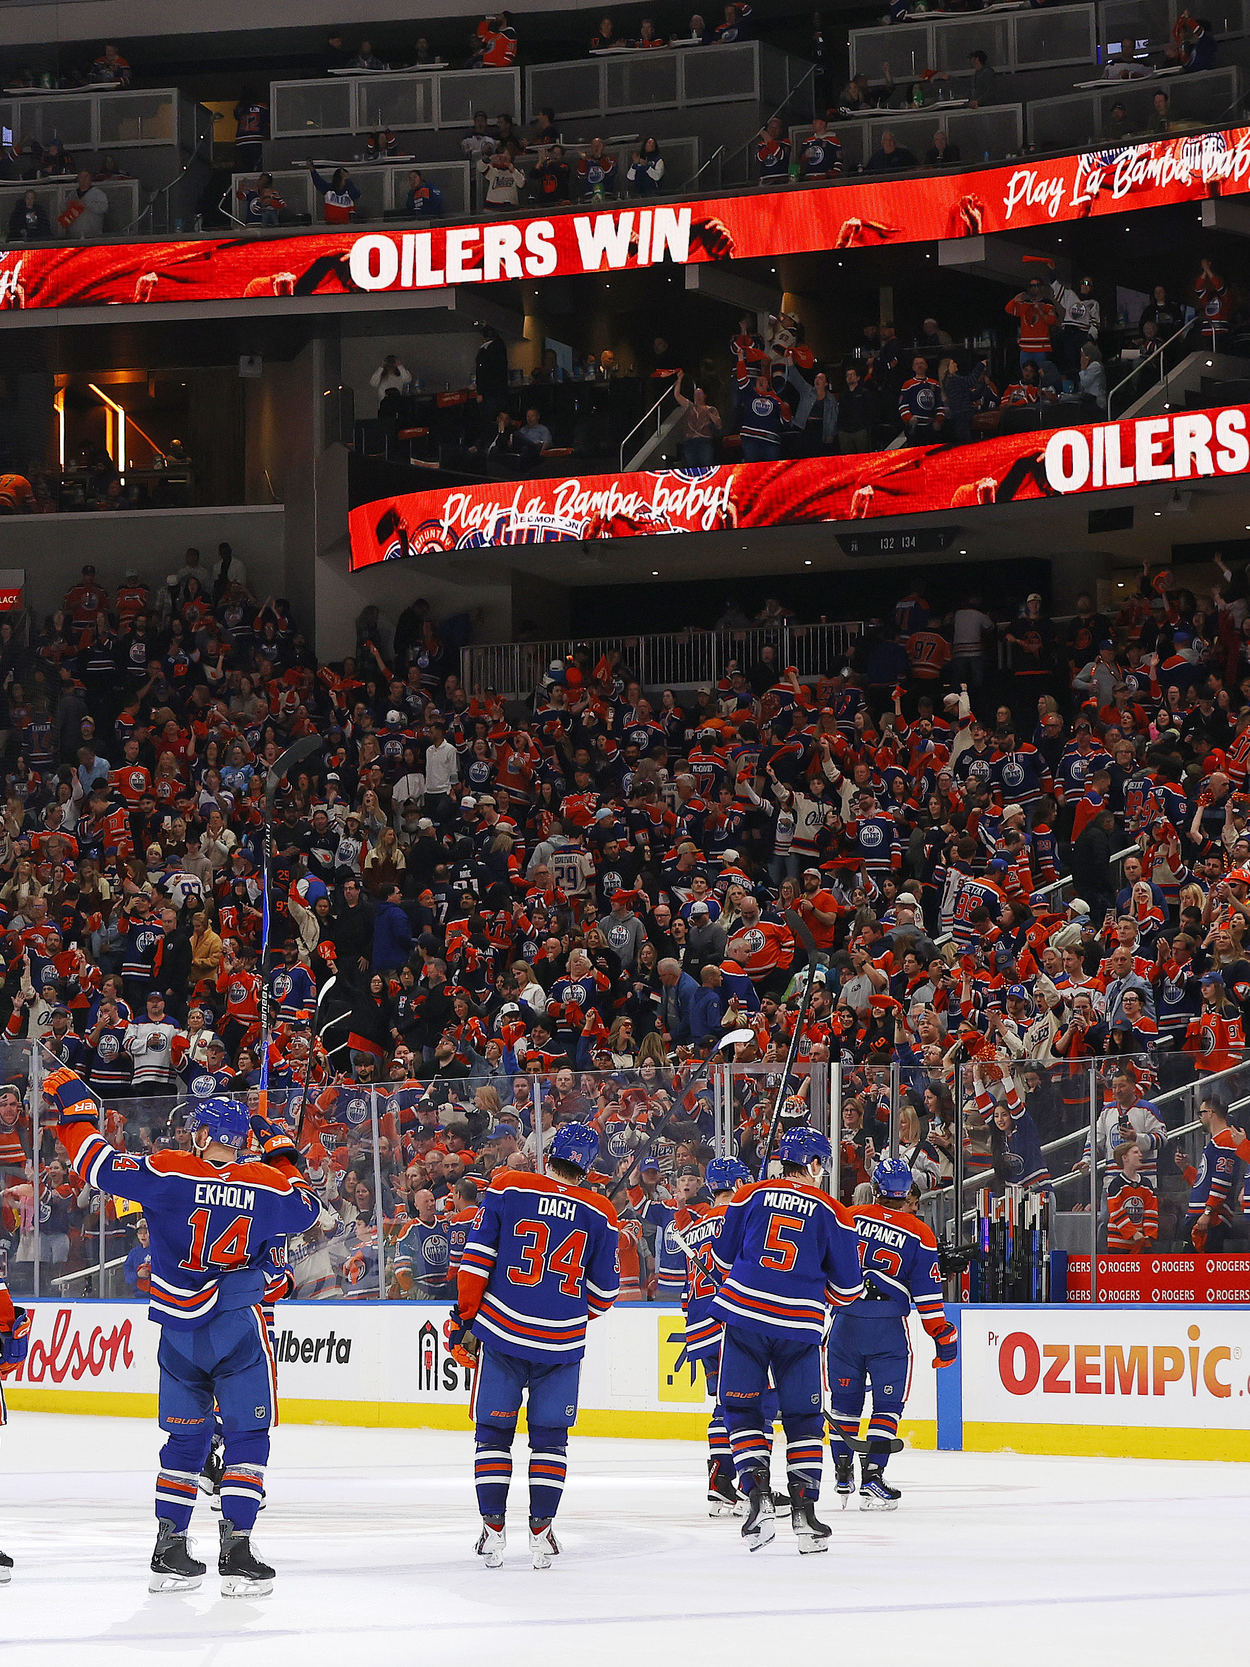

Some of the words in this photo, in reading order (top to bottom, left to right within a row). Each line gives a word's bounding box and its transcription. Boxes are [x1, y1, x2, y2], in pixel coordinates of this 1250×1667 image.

[1003, 170, 1066, 219] Play
[1069, 152, 1106, 206] La
[1202, 133, 1250, 182] bab
[349, 220, 558, 290] OILERS
[573, 207, 692, 270] WIN
[1045, 409, 1250, 493] OILERS
[440, 493, 499, 541] Play
[506, 485, 547, 533] La
[553, 480, 643, 522] Bamba
[647, 475, 735, 532] baby!
[880, 537, 894, 549] 132
[901, 536, 916, 548] 134
[915, 640, 937, 661] 97
[554, 865, 578, 891] 29
[417, 1125, 425, 1134] P
[1215, 1156, 1237, 1174] 25
[194, 1183, 256, 1212] EKHOLM
[537, 1196, 578, 1222] DACH
[763, 1191, 819, 1218] MURPHY
[177, 1206, 255, 1273] 14
[758, 1212, 806, 1273] 5
[855, 1218, 908, 1250] KAPANEN
[506, 1217, 589, 1300] 34
[1067, 1261, 1091, 1273] GERS
[1108, 1261, 1141, 1273] ROGERS
[1161, 1261, 1195, 1273] ROGERS
[1216, 1261, 1250, 1273] ROGERS
[1067, 1290, 1091, 1301] GERS
[1108, 1290, 1141, 1301] ROGERS
[1161, 1290, 1195, 1301] ROGERS
[1216, 1290, 1250, 1301] ROGERS
[273, 1330, 352, 1364] lberta
[988, 1331, 999, 1346] Pr
[724, 1390, 760, 1400] BAUER
